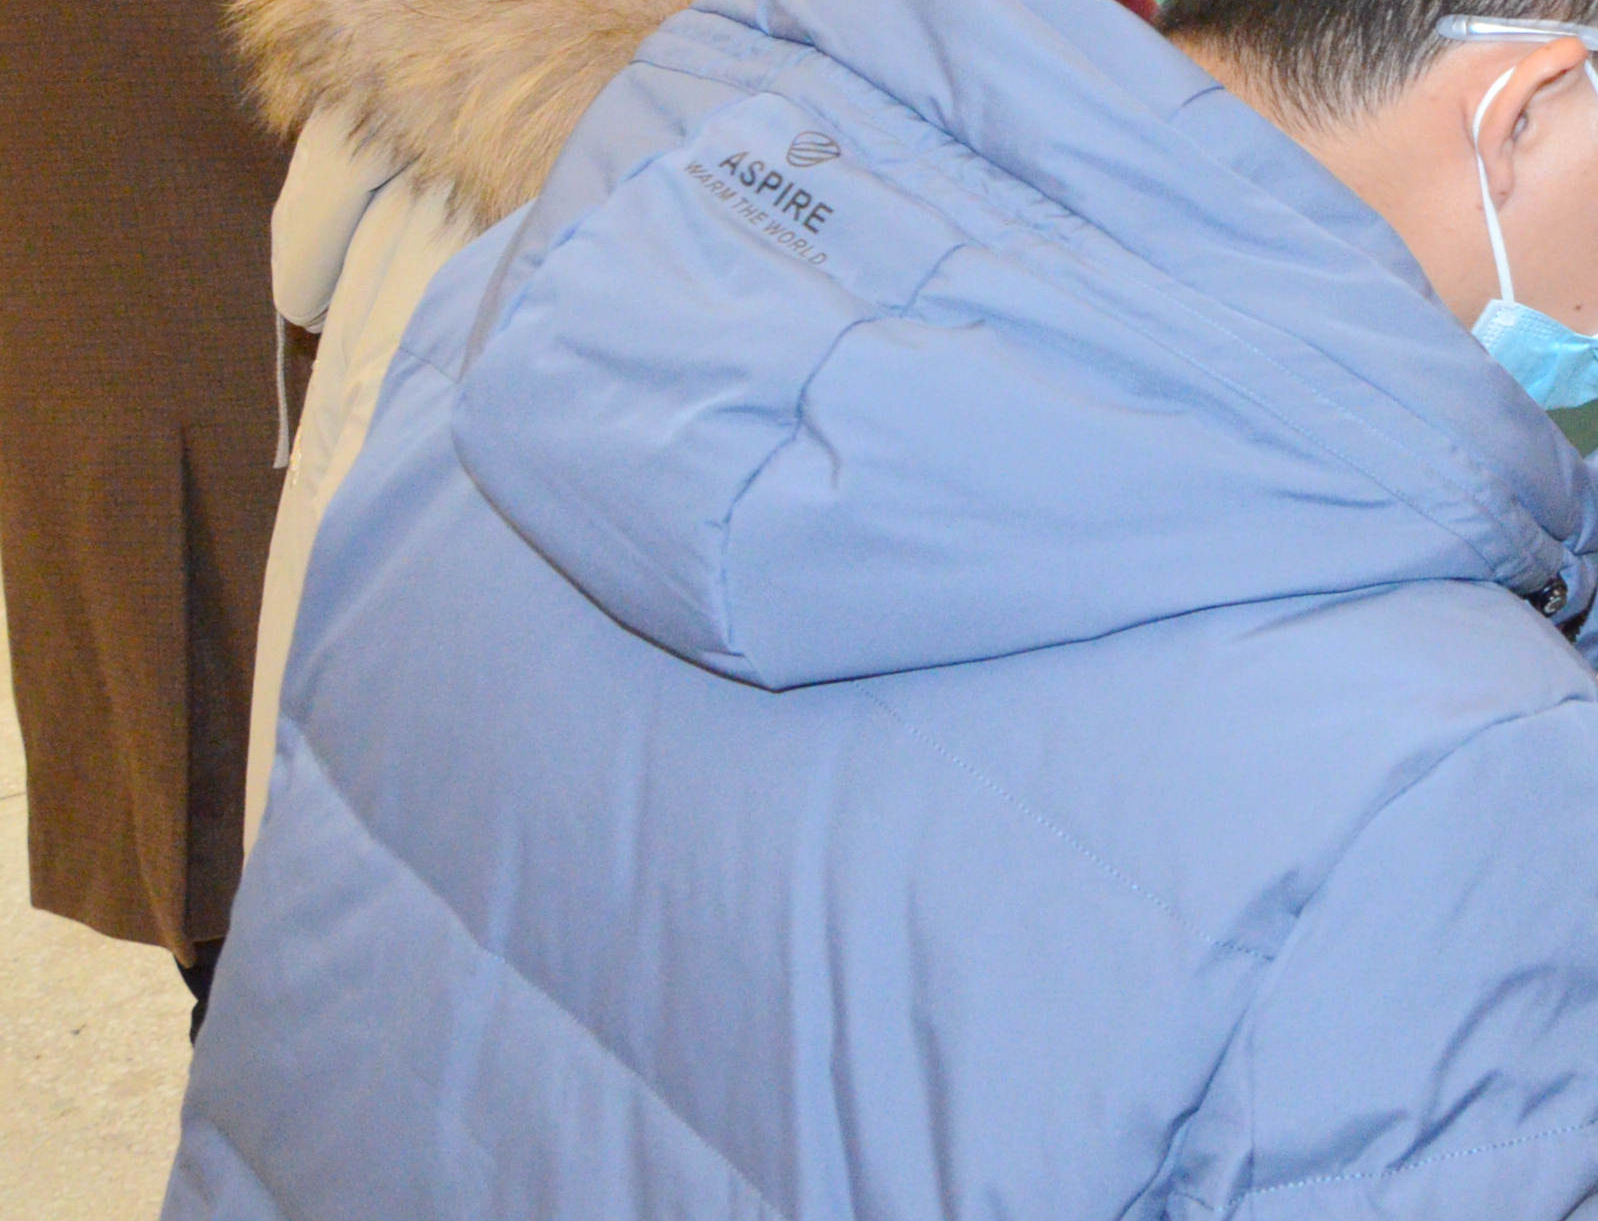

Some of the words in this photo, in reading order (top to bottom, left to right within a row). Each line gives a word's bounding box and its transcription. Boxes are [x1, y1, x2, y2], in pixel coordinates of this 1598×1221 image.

[684, 161, 737, 201] WARM
[732, 197, 768, 225] THE
[763, 220, 828, 265] WORLD
[719, 151, 834, 235] ASPIRE
